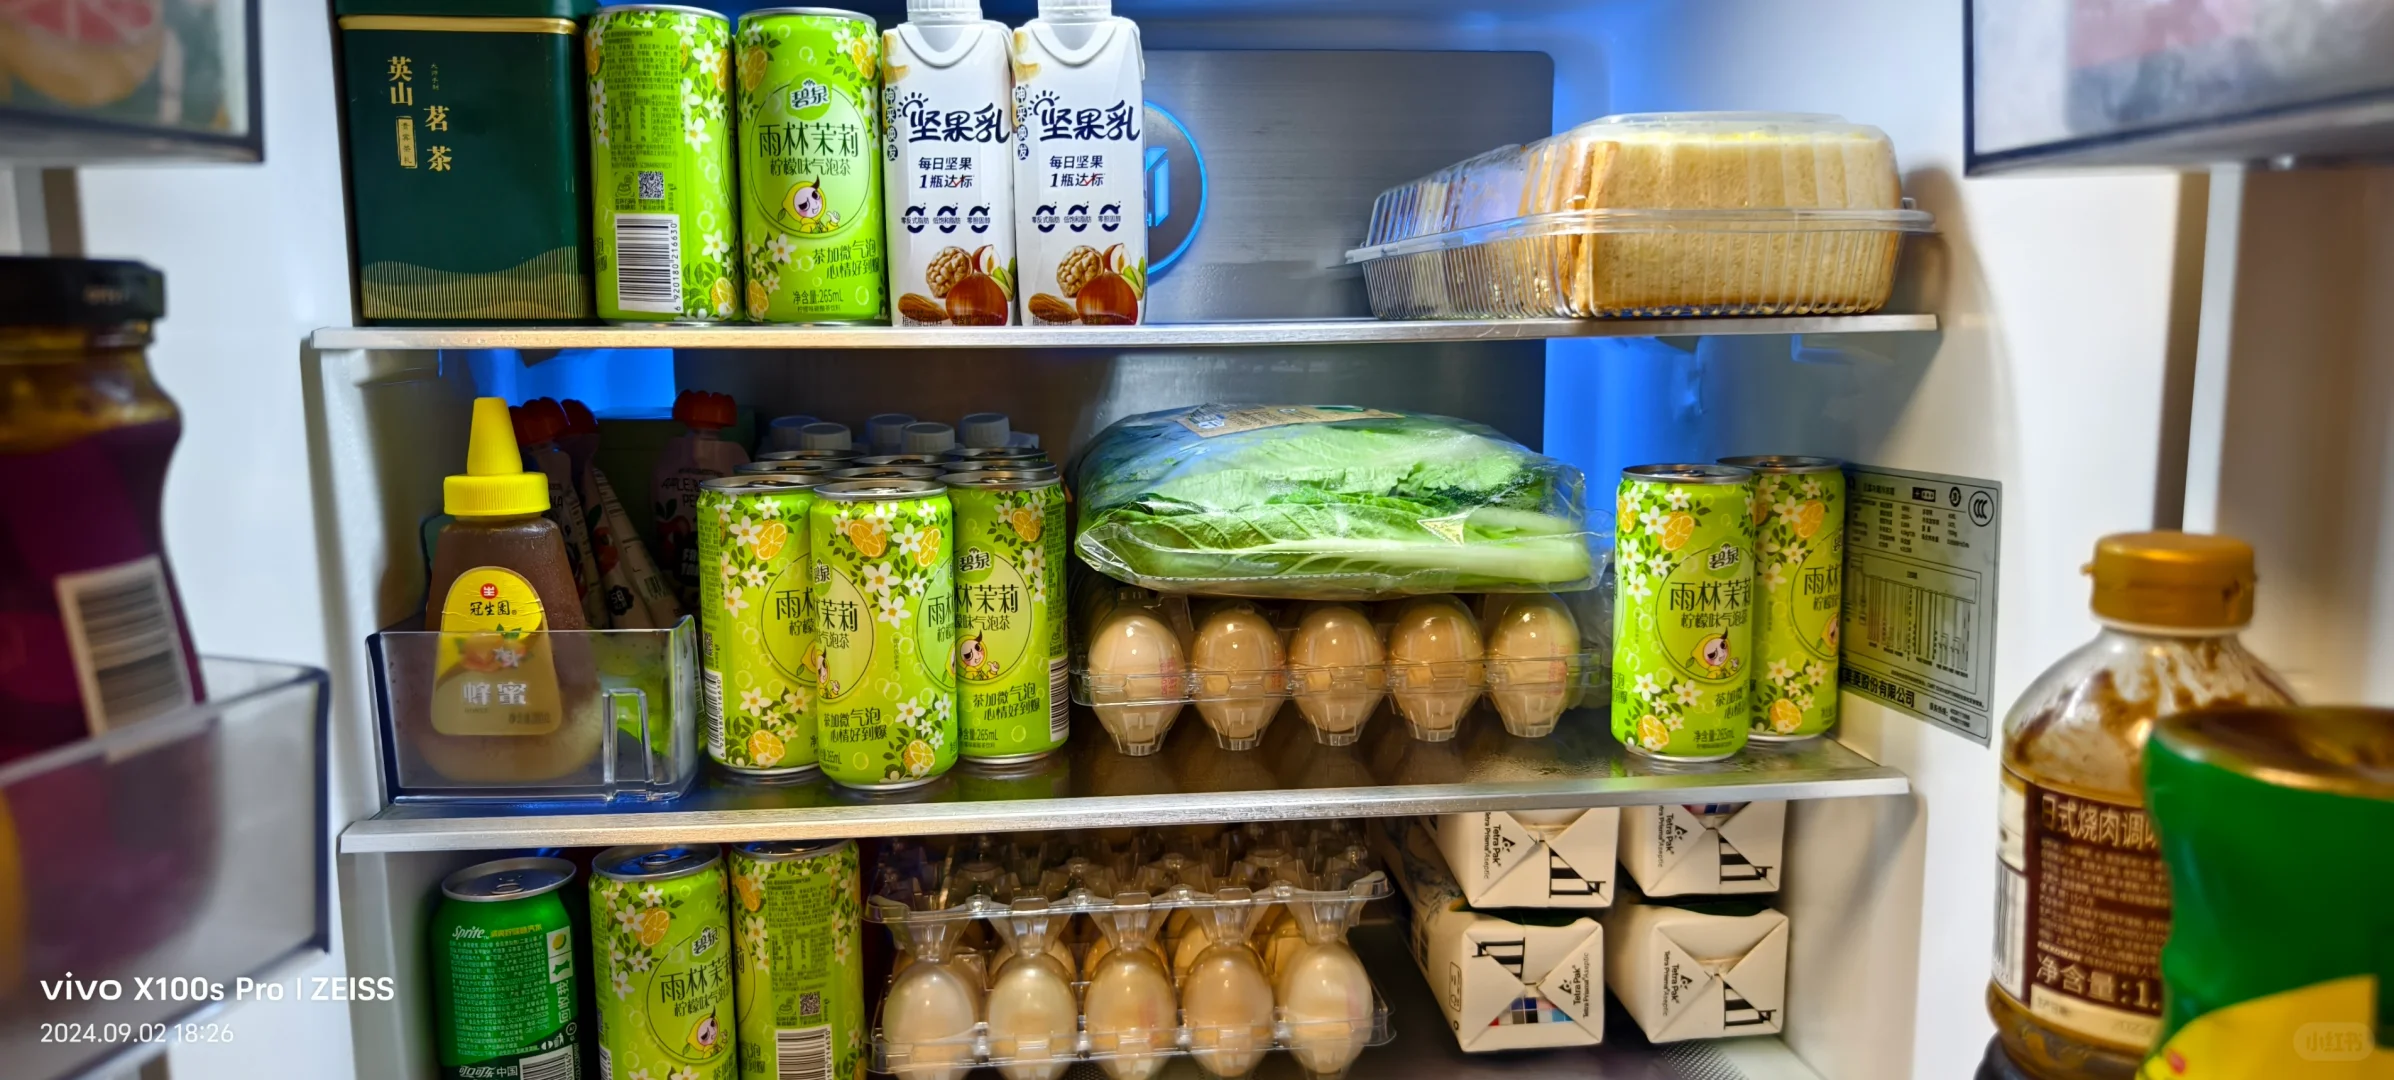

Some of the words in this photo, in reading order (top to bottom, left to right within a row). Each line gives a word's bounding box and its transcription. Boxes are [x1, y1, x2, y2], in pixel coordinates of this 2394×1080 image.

[387, 56, 413, 106] 英山
[790, 83, 829, 109] 碧泉
[908, 102, 1011, 143] 坚果乳
[1039, 100, 1141, 142] 坚果乳
[423, 105, 453, 171] 茗茶
[758, 121, 859, 158] 雨林茉莉
[770, 158, 851, 176] 柠檬味气泡茶
[918, 156, 973, 171] 每日坚果
[1049, 155, 1104, 170] 每日坚果
[919, 174, 973, 189] 1瓶达标
[1049, 173, 1104, 188] 1瓶达标
[813, 238, 877, 266] 茶加微气泡
[826, 257, 880, 280] 心情好到爆
[960, 551, 991, 572] 碧泉
[1708, 546, 1741, 570] 碧泉
[463, 681, 527, 706] 蜂蜜
[972, 681, 1036, 708] 茶加微气泡
[824, 707, 881, 728] 茶加微气泡
[984, 697, 1040, 721] 心情好到爆
[830, 725, 887, 743] 心情好到爆
[1492, 824, 1501, 846] Tetra
[1666, 813, 1675, 835] Tetra
[452, 925, 485, 940] Sprite
[692, 926, 719, 956] 碧泉
[1671, 963, 1680, 985] Tetra
[1573, 985, 1581, 1006] Tetra
[496, 1065, 518, 1077] 中国
